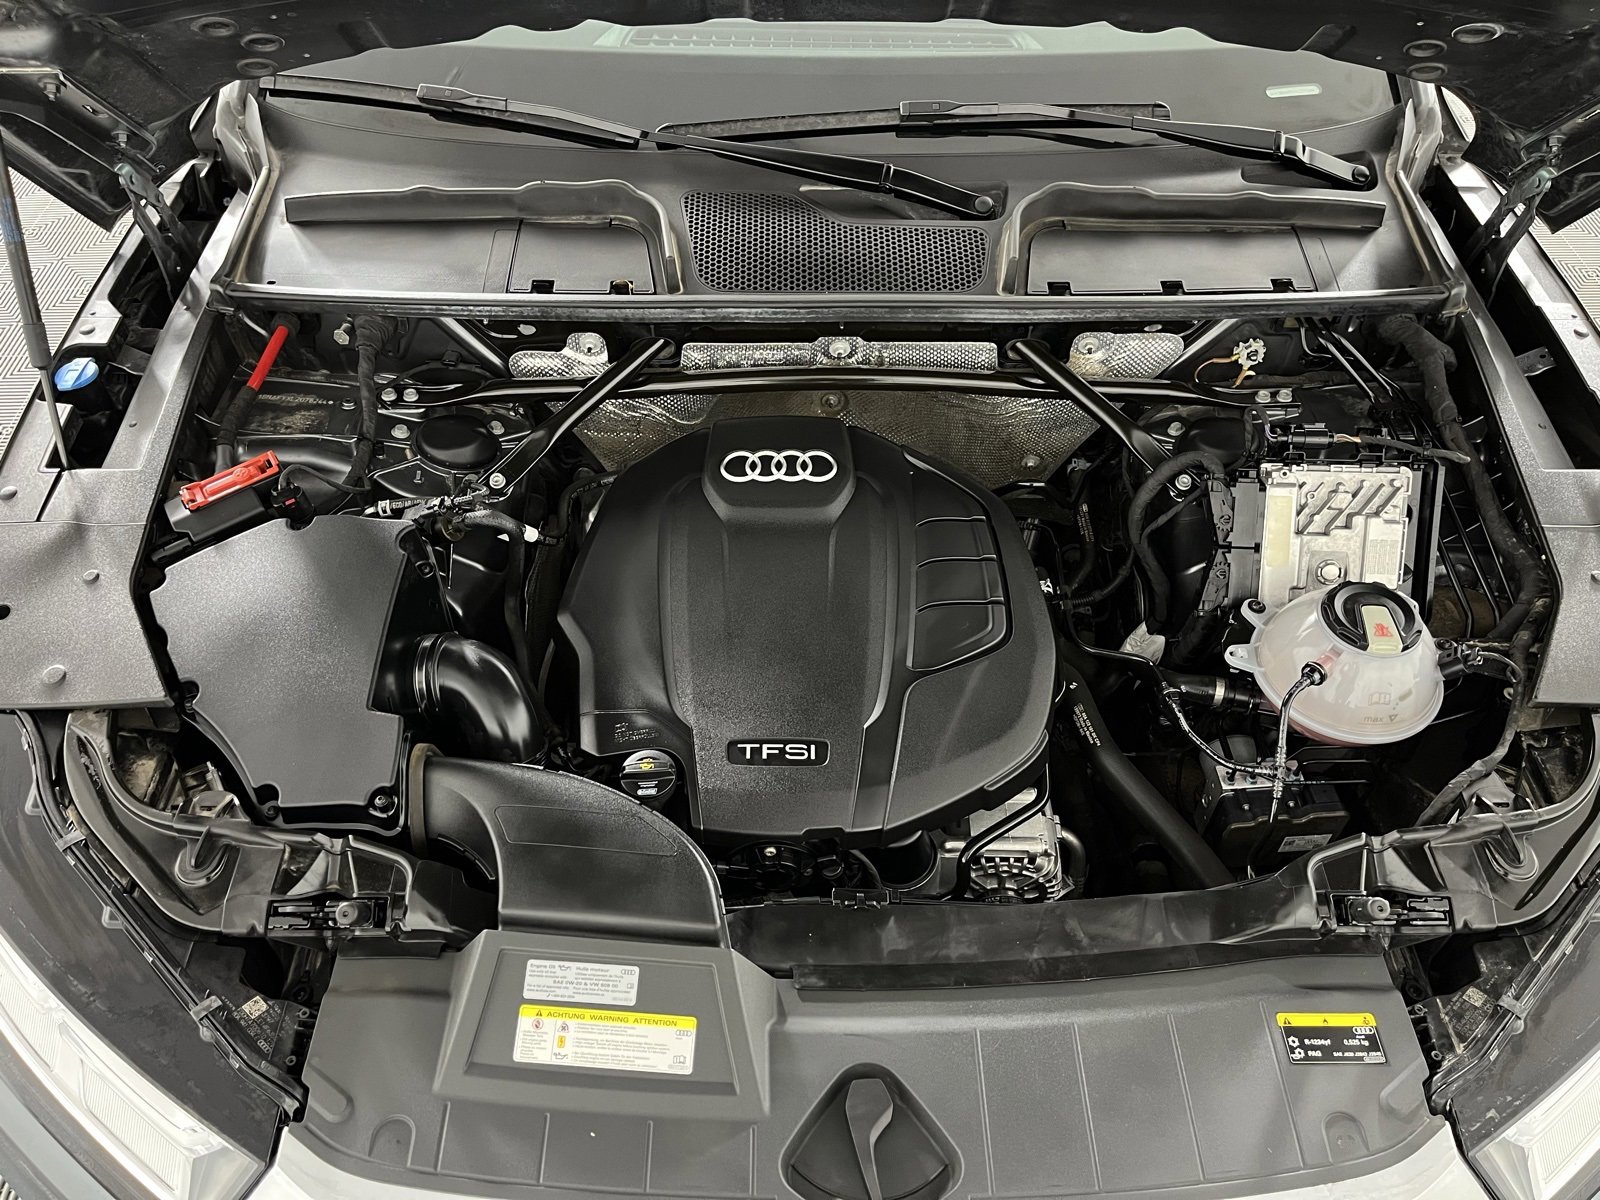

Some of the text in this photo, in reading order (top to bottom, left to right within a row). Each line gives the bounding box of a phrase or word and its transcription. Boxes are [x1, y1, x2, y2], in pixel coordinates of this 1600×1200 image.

[737, 744, 816, 760] TFSI
[546, 1011, 678, 1027] ACHTUNG WARNING ATTENTION
